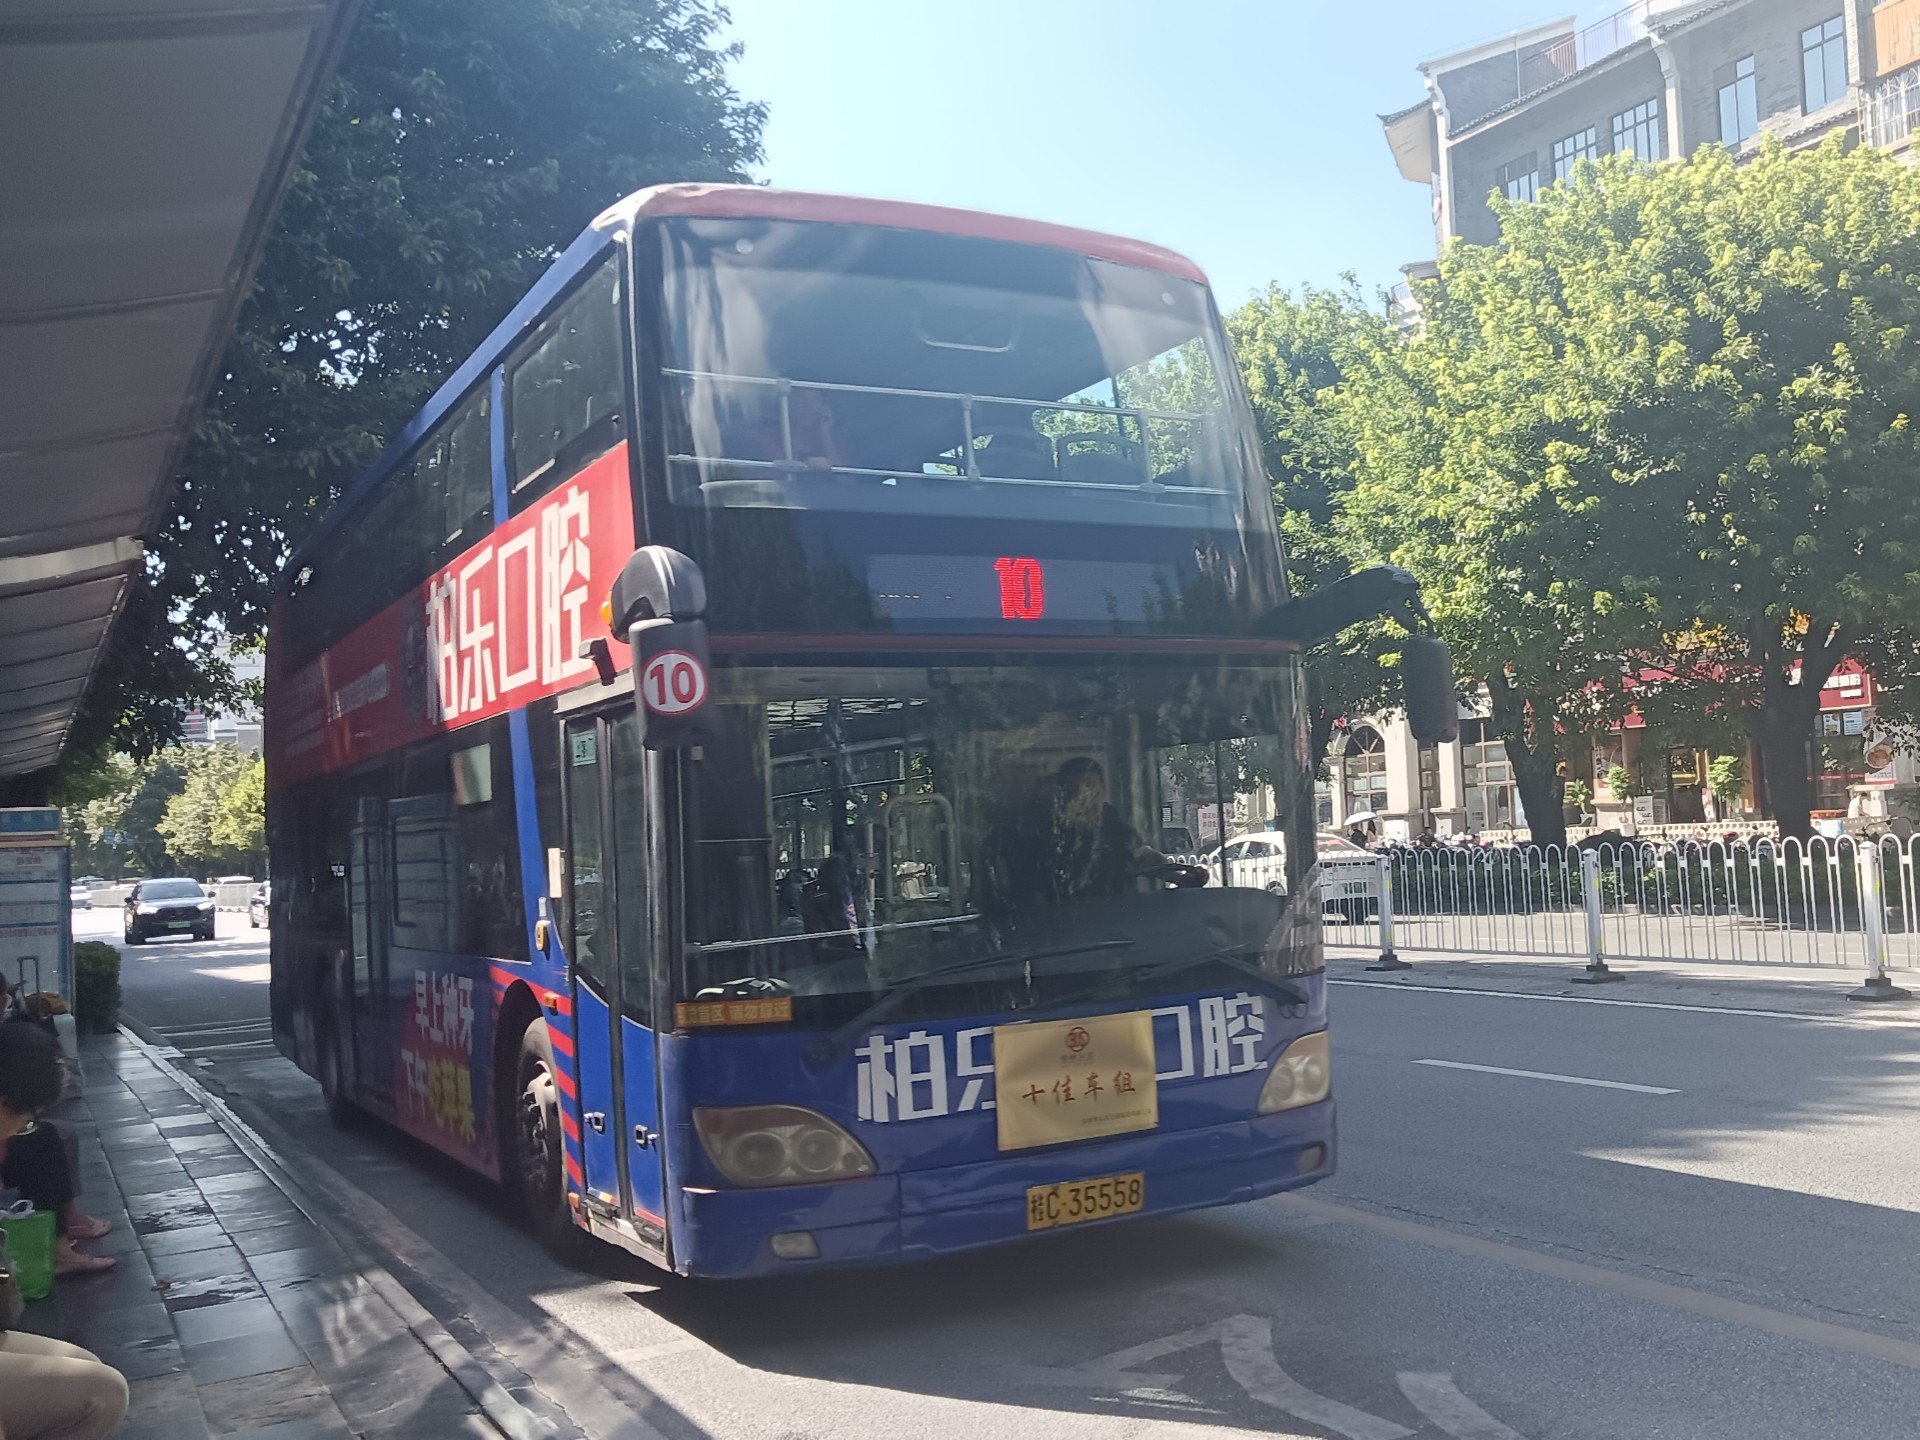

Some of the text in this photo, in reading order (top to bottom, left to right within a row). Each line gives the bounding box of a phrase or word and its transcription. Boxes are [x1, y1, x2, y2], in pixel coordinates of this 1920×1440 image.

[426, 485, 593, 725] 柏乐口腔
[993, 556, 1044, 620] 10
[650, 662, 697, 706] 10
[677, 1004, 726, 1026] 盲区
[1022, 1070, 1136, 1104] 十佳车组
